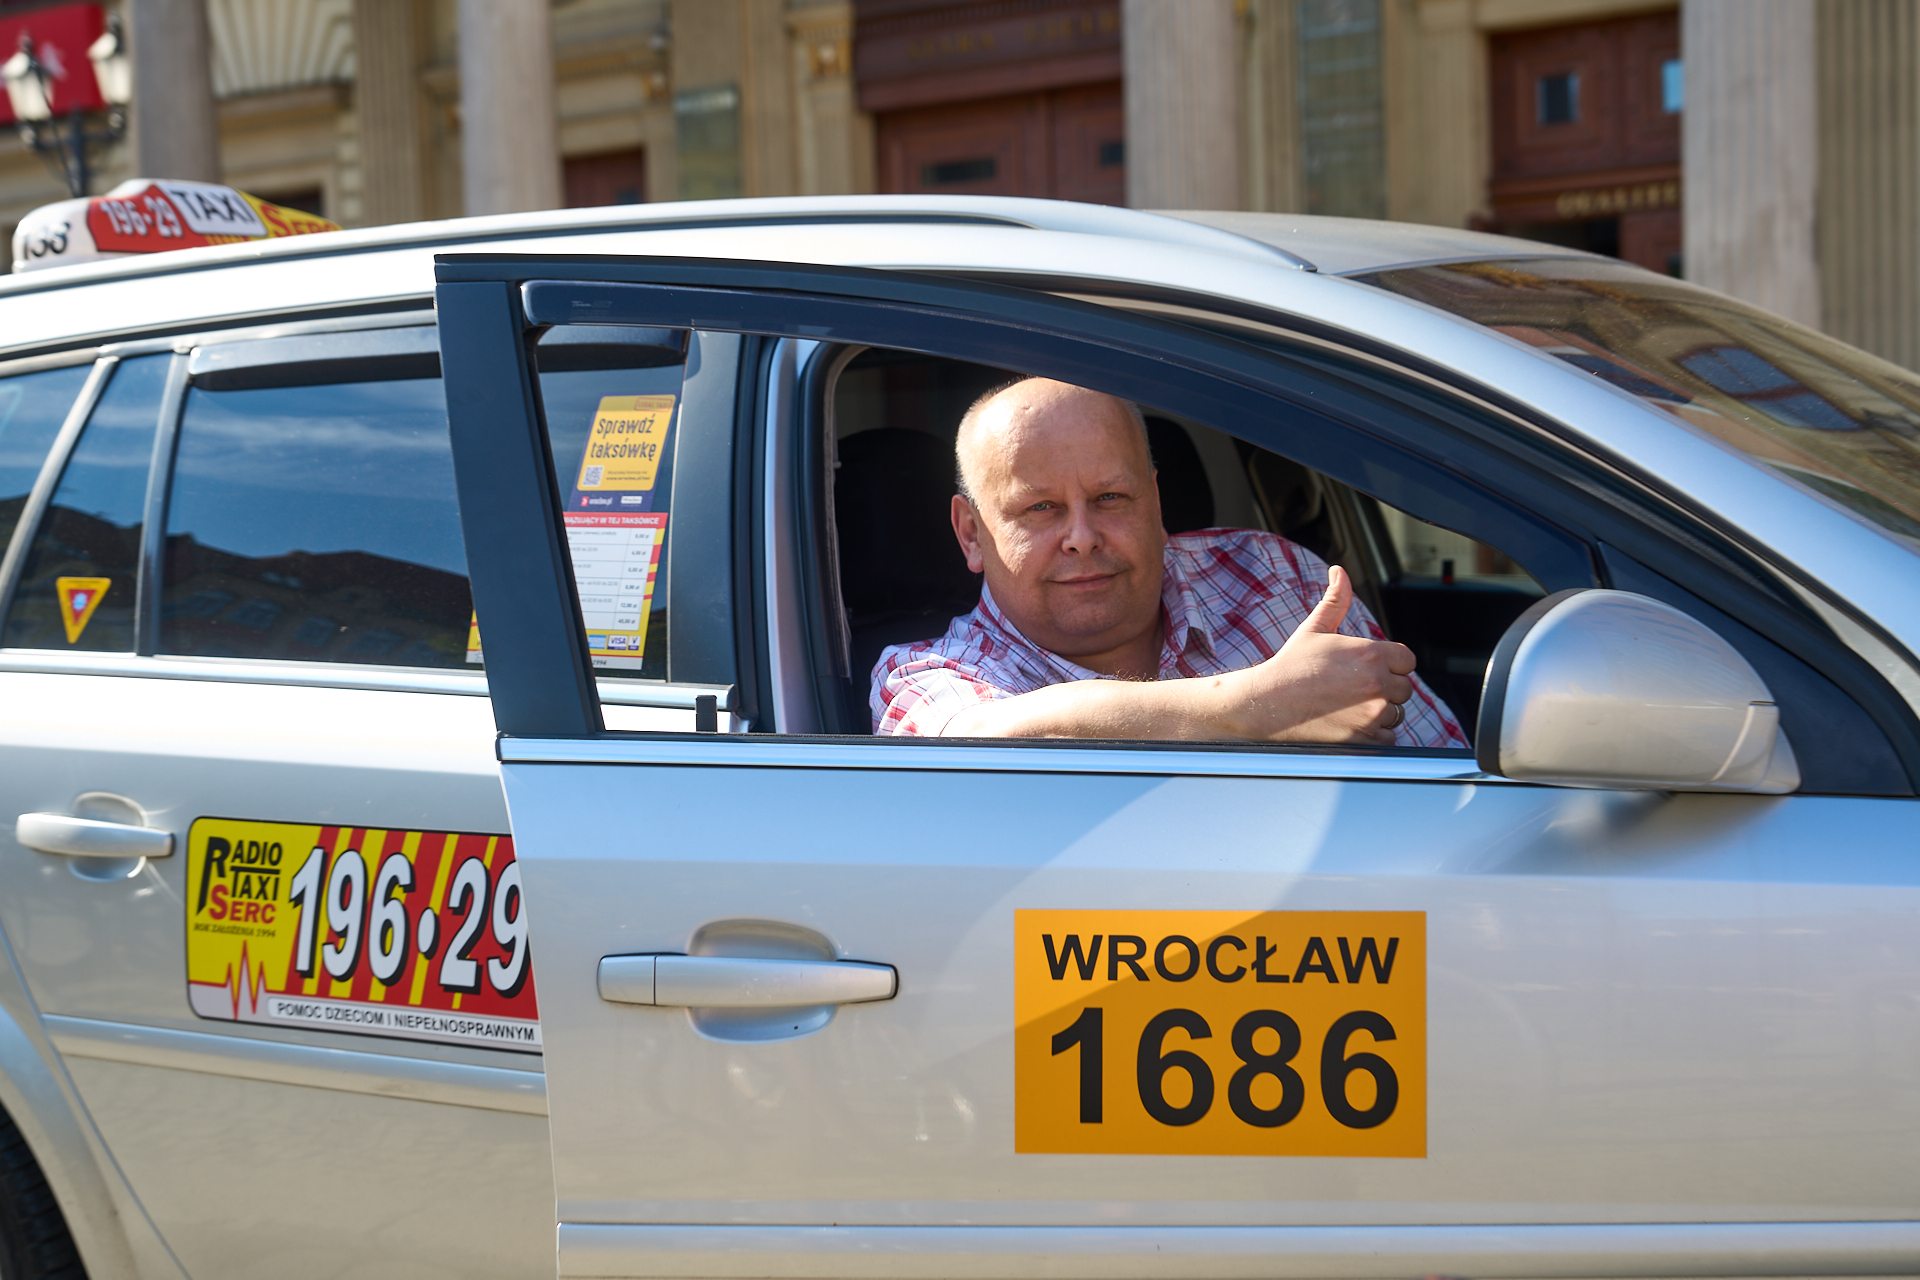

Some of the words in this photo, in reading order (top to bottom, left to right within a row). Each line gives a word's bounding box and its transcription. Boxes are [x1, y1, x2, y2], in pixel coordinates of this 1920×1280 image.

[171, 190, 257, 224] TAXI
[597, 413, 656, 439] Sprawdź
[590, 438, 657, 462] taksówkę
[611, 637, 626, 645] VISA
[229, 866, 281, 902] TAXI
[209, 884, 276, 925] SERC
[256, 928, 276, 938] 1994
[1041, 934, 1400, 985] WROCŁAW
[278, 1002, 322, 1019] POMOC
[326, 1006, 385, 1025] DZIECIOM
[395, 1014, 535, 1042] NIEPEŁNOSPRAWNYM
[1051, 1007, 1400, 1129] 1686
